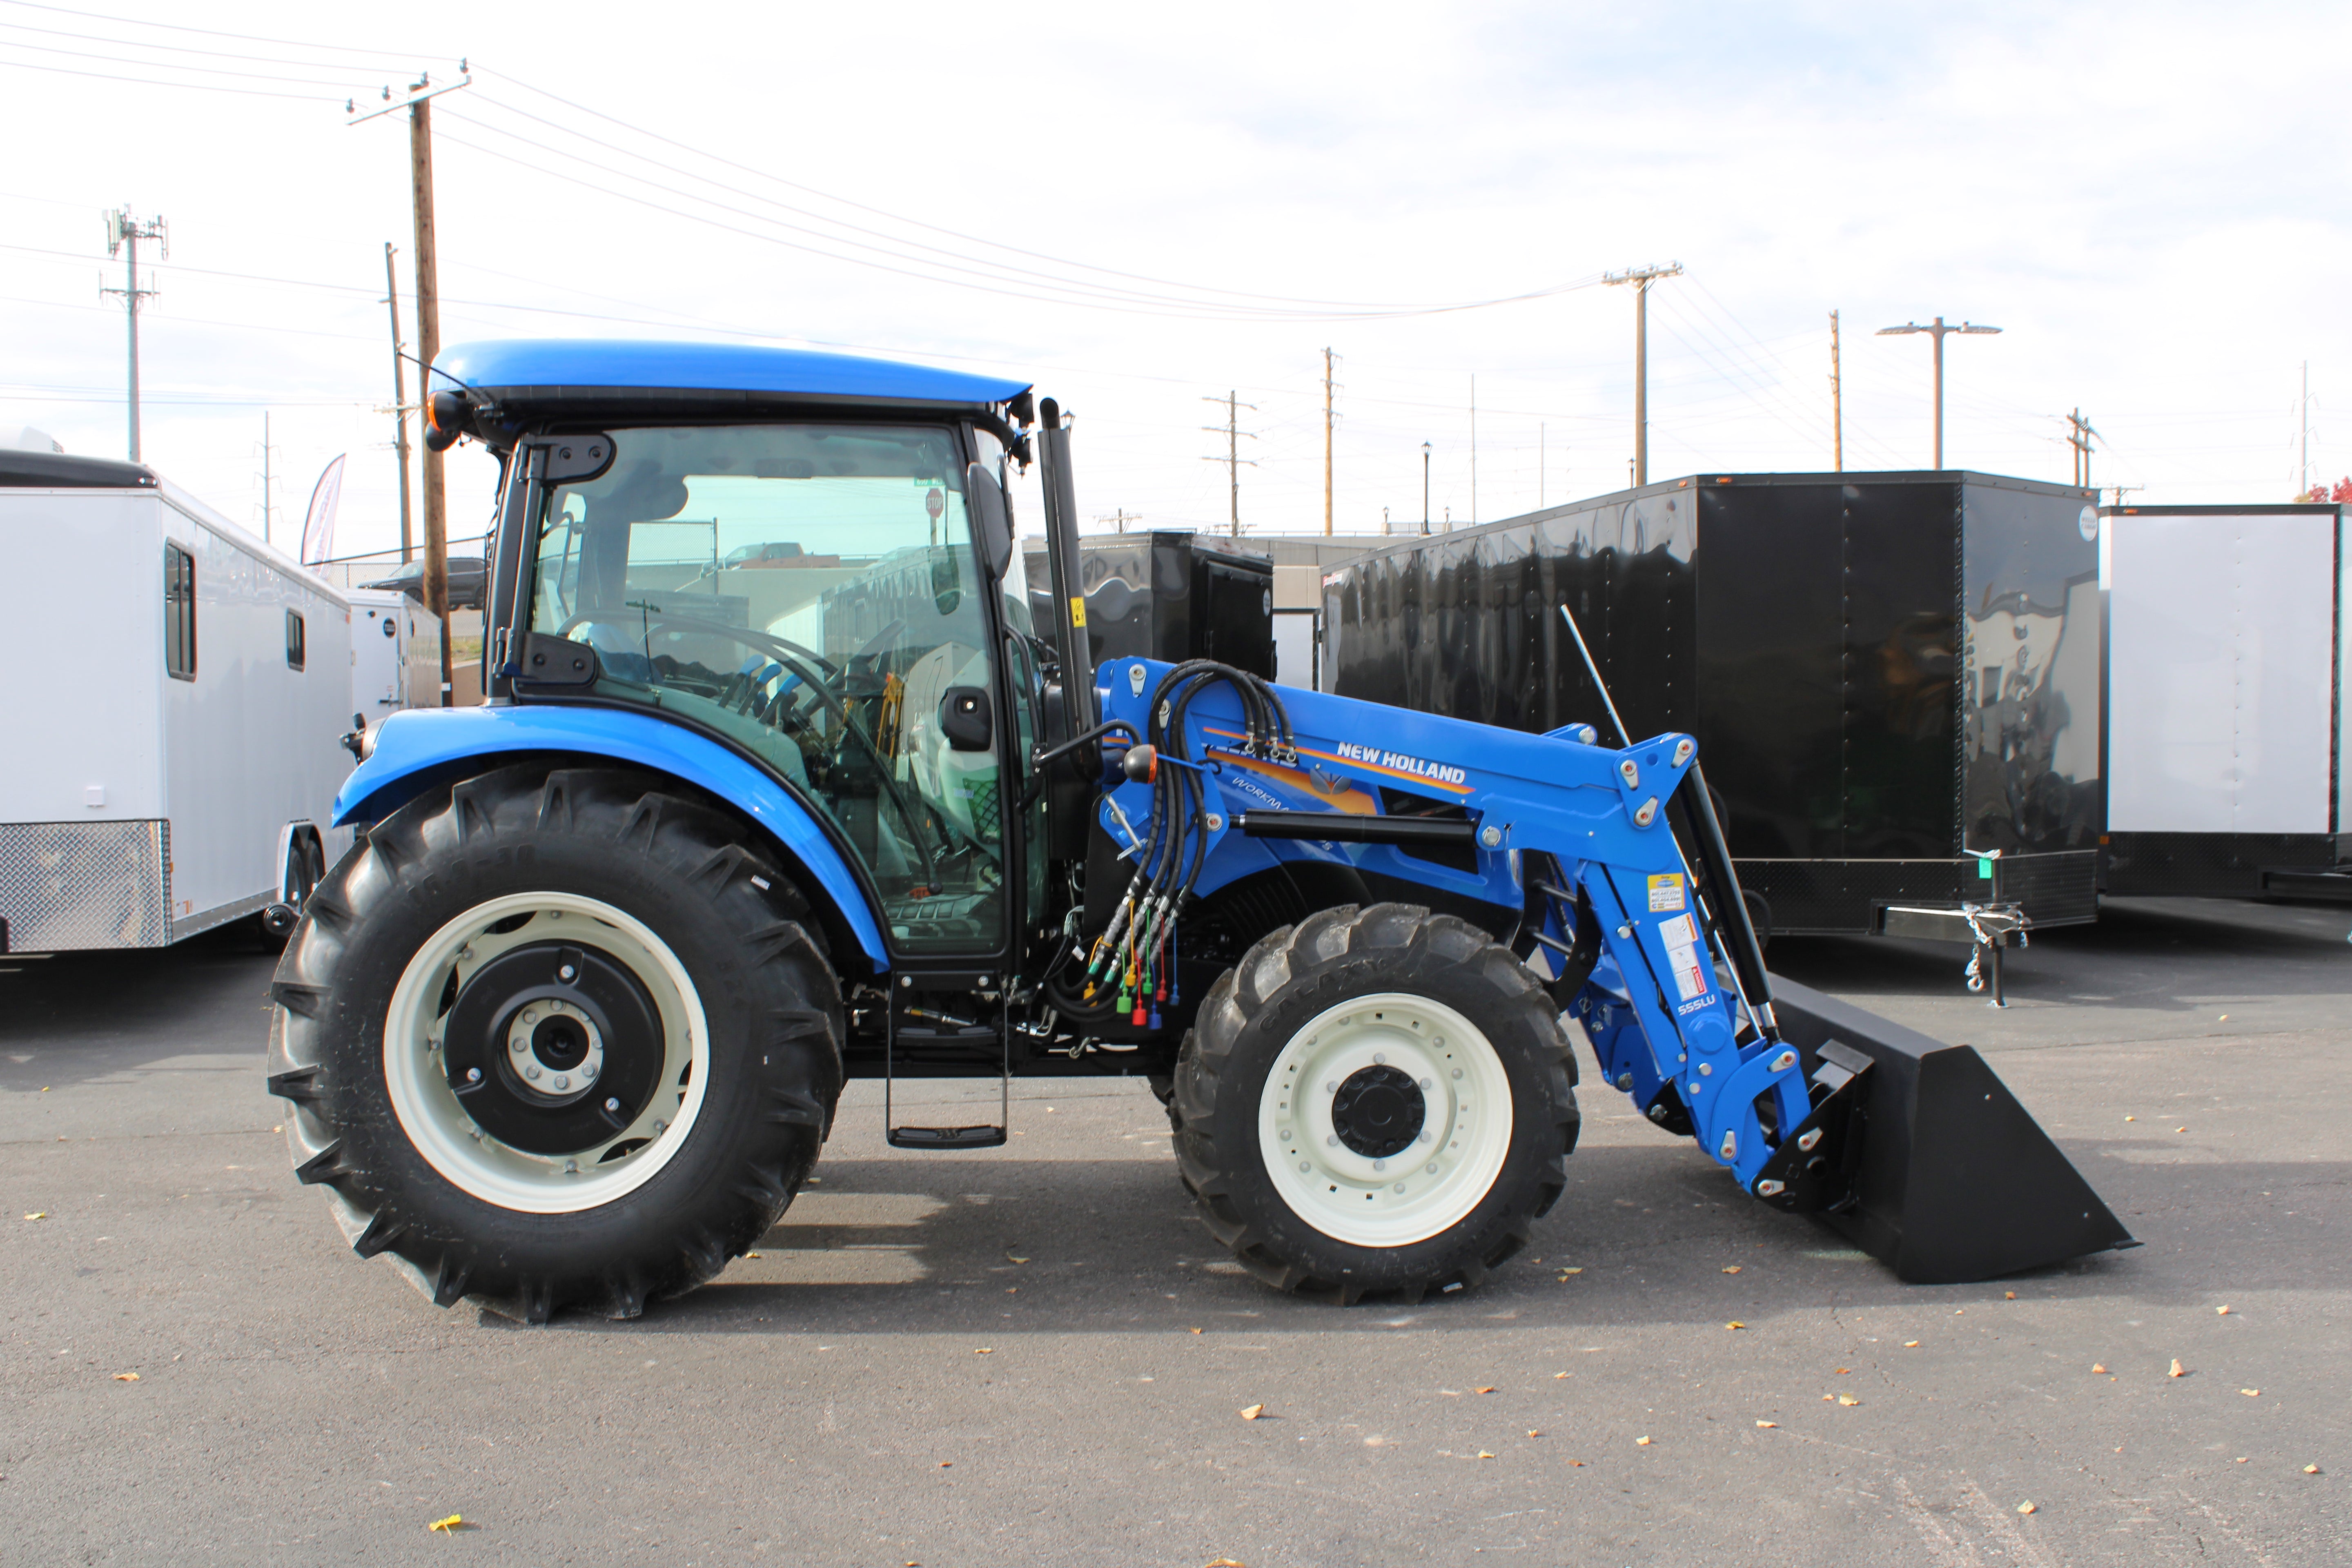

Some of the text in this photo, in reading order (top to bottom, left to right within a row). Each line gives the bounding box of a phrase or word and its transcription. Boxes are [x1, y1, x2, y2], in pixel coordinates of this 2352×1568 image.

[927, 497, 943, 509] STOP
[1336, 742, 1466, 784] NEW HOLLAND
[1694, 973, 1704, 992] DANGER
[1258, 957, 1385, 1033] GALAXY
[1677, 994, 1716, 1016] 555LU
